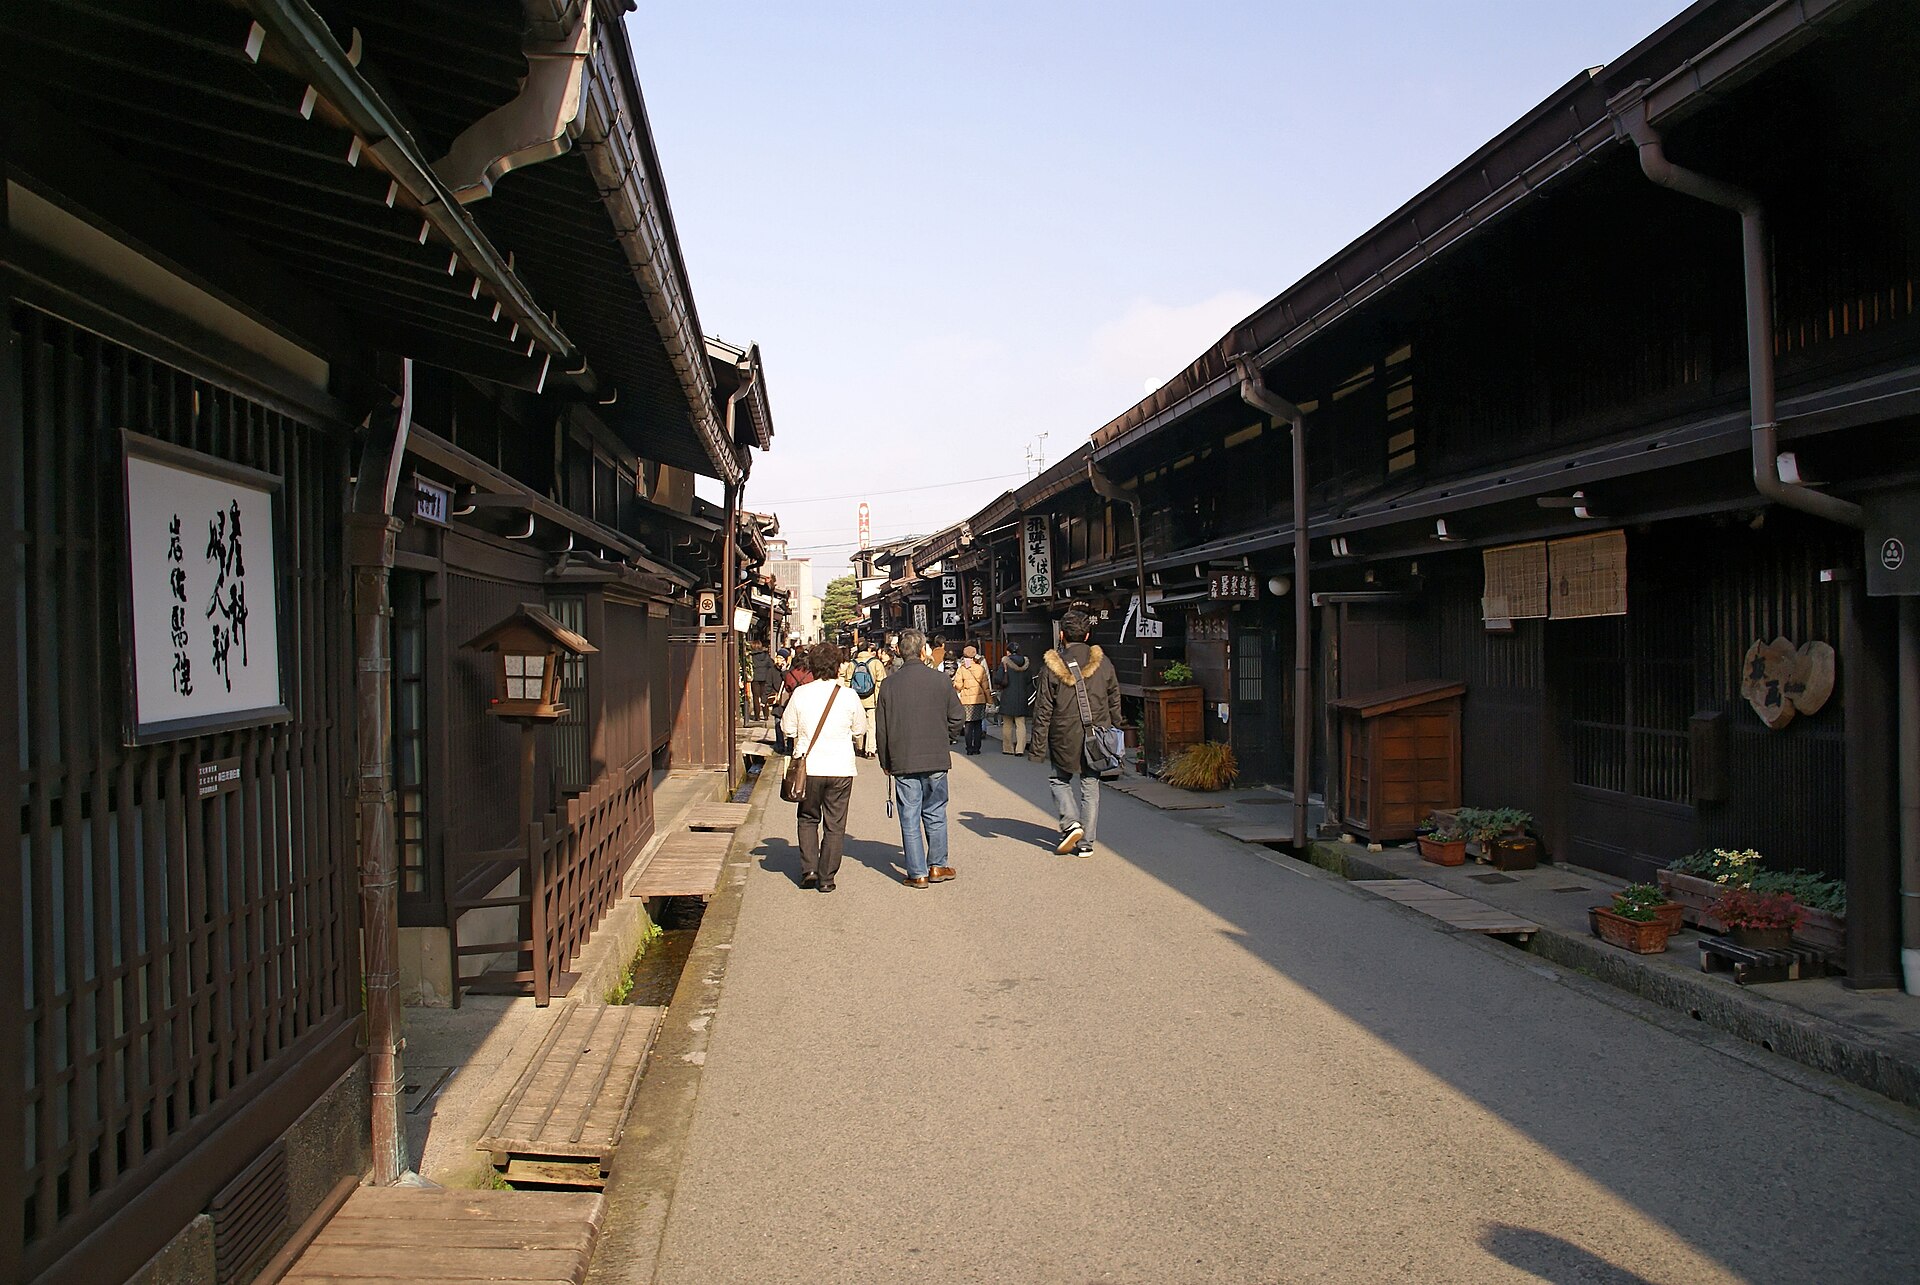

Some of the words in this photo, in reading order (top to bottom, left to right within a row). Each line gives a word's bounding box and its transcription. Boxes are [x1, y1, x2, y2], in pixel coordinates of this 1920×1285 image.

[206, 510, 232, 693] 婦人科
[227, 498, 248, 667] 産科
[860, 514, 869, 548] 十六
